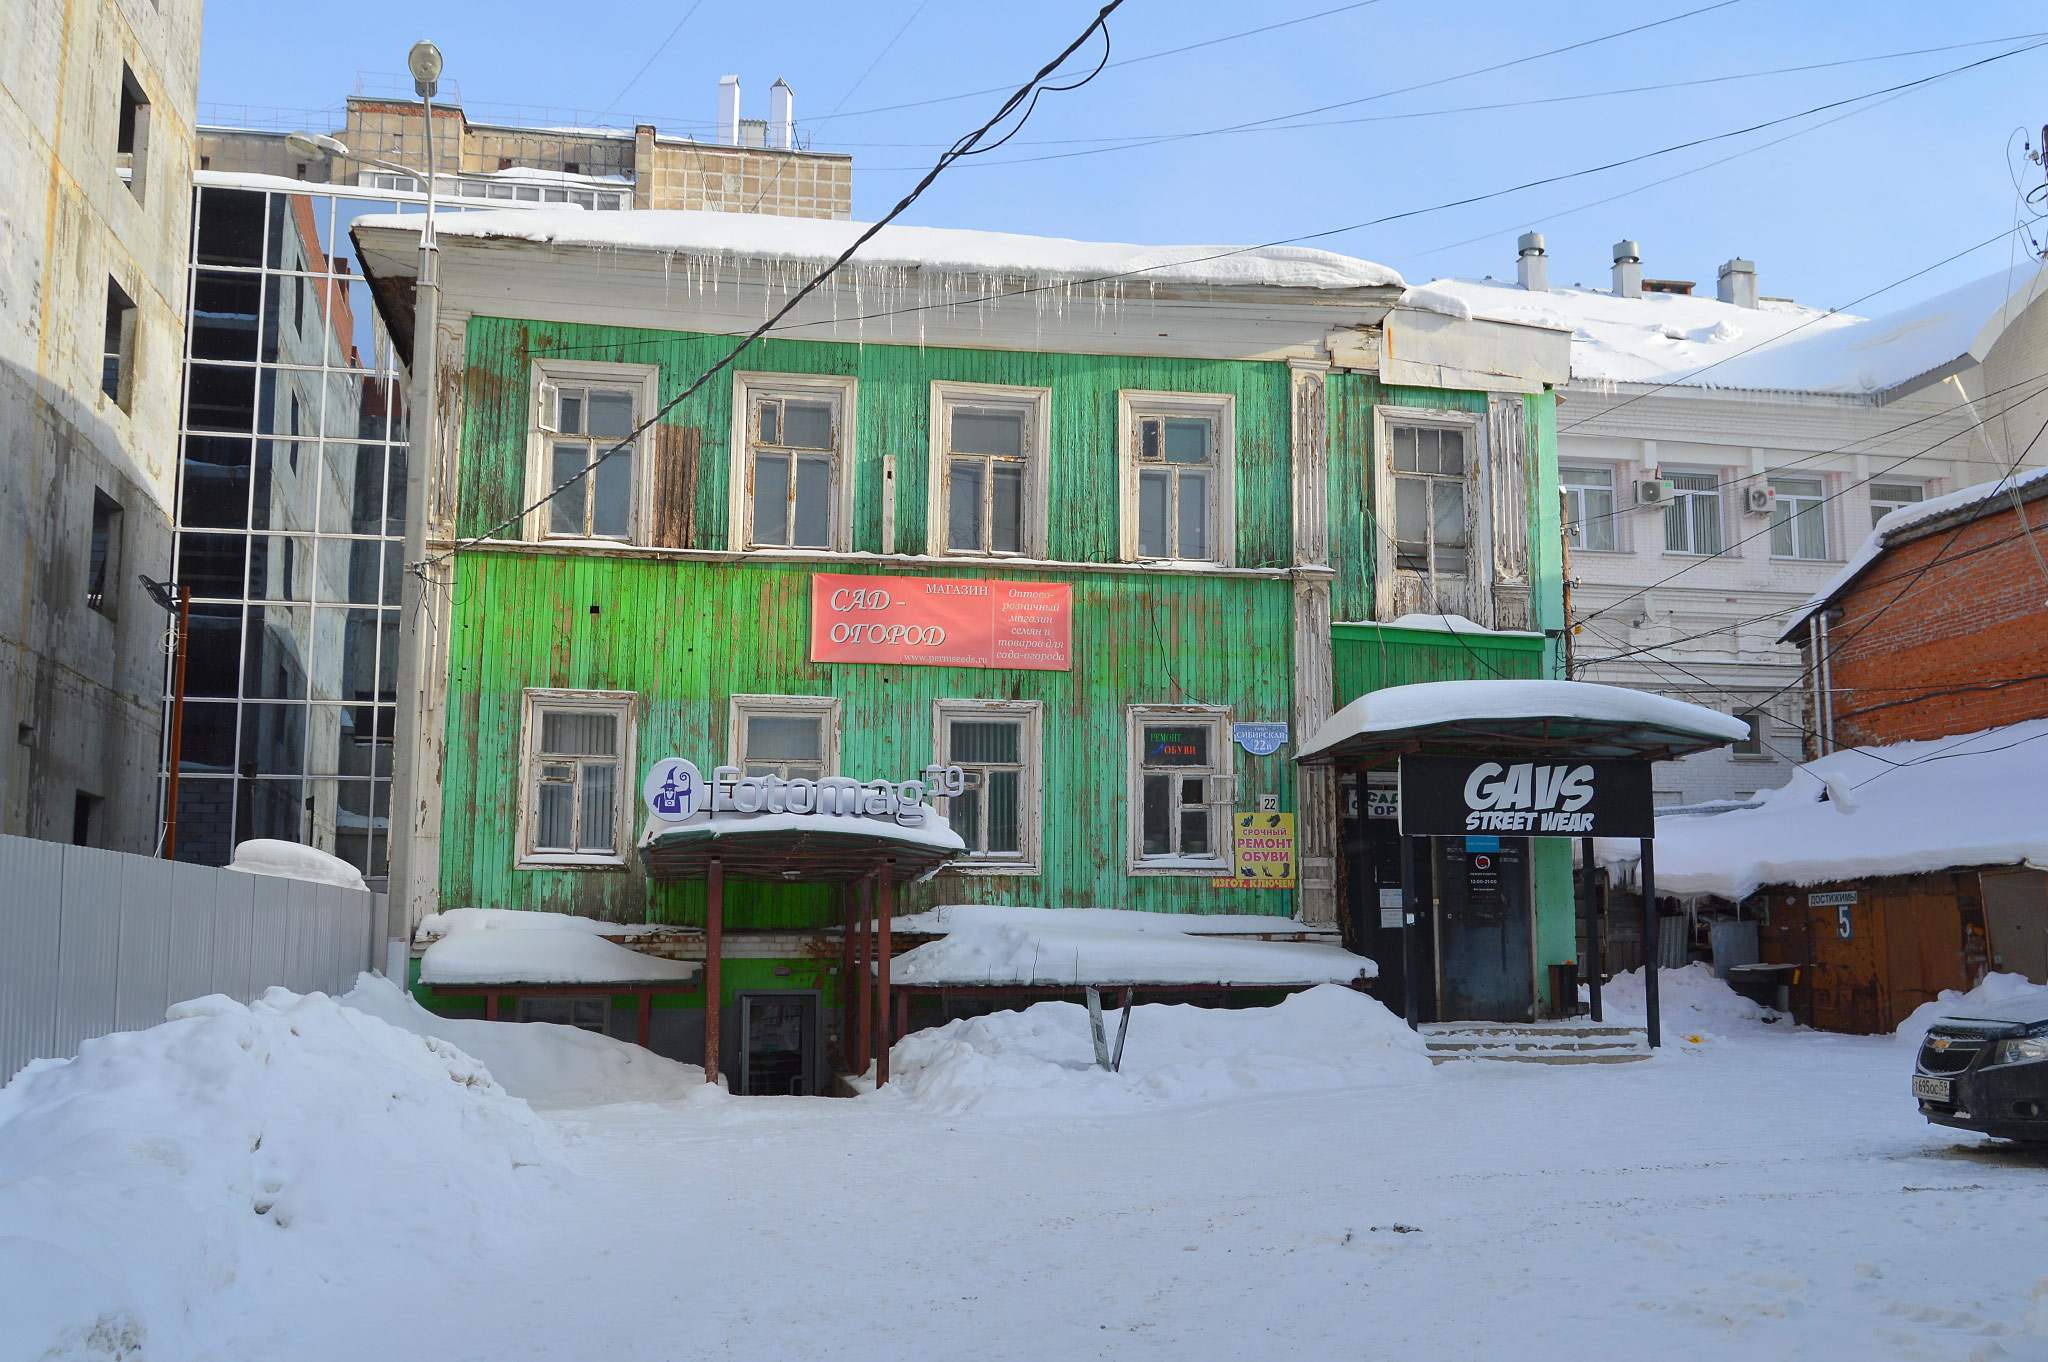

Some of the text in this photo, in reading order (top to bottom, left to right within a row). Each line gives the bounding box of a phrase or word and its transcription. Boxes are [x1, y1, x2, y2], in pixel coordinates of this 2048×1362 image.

[925, 584, 989, 596] МАГАЗИН
[1008, 588, 1055, 599] Оптово-
[830, 588, 891, 612] САД
[1001, 602, 1060, 612] розничный
[1008, 615, 1053, 624] магазин
[830, 622, 946, 646] ОГОРОД
[1011, 627, 1042, 636] семян
[998, 639, 1064, 649] товаров для
[903, 653, 988, 664] www.permseeds.ru
[996, 649, 1065, 662] сада-огорода
[1150, 733, 1182, 743] РЕМОНТ
[1236, 731, 1285, 739] СИБИРСКАЯ
[1164, 745, 1196, 755] ОБУВИ
[925, 764, 965, 798] 59
[1464, 762, 1595, 812] GAVS
[1264, 798, 1276, 810] 22
[1465, 811, 1595, 832] STREET WEAR
[1242, 828, 1287, 836] СРОЧНЫЙ
[1237, 838, 1293, 849] РЕМОНТ
[1241, 851, 1289, 862] ОБУВИ
[1212, 878, 1247, 888] ИЗГОТ.
[1810, 893, 1857, 905] ДОСТИЖИМЫ
[1839, 905, 1850, 938] 5
